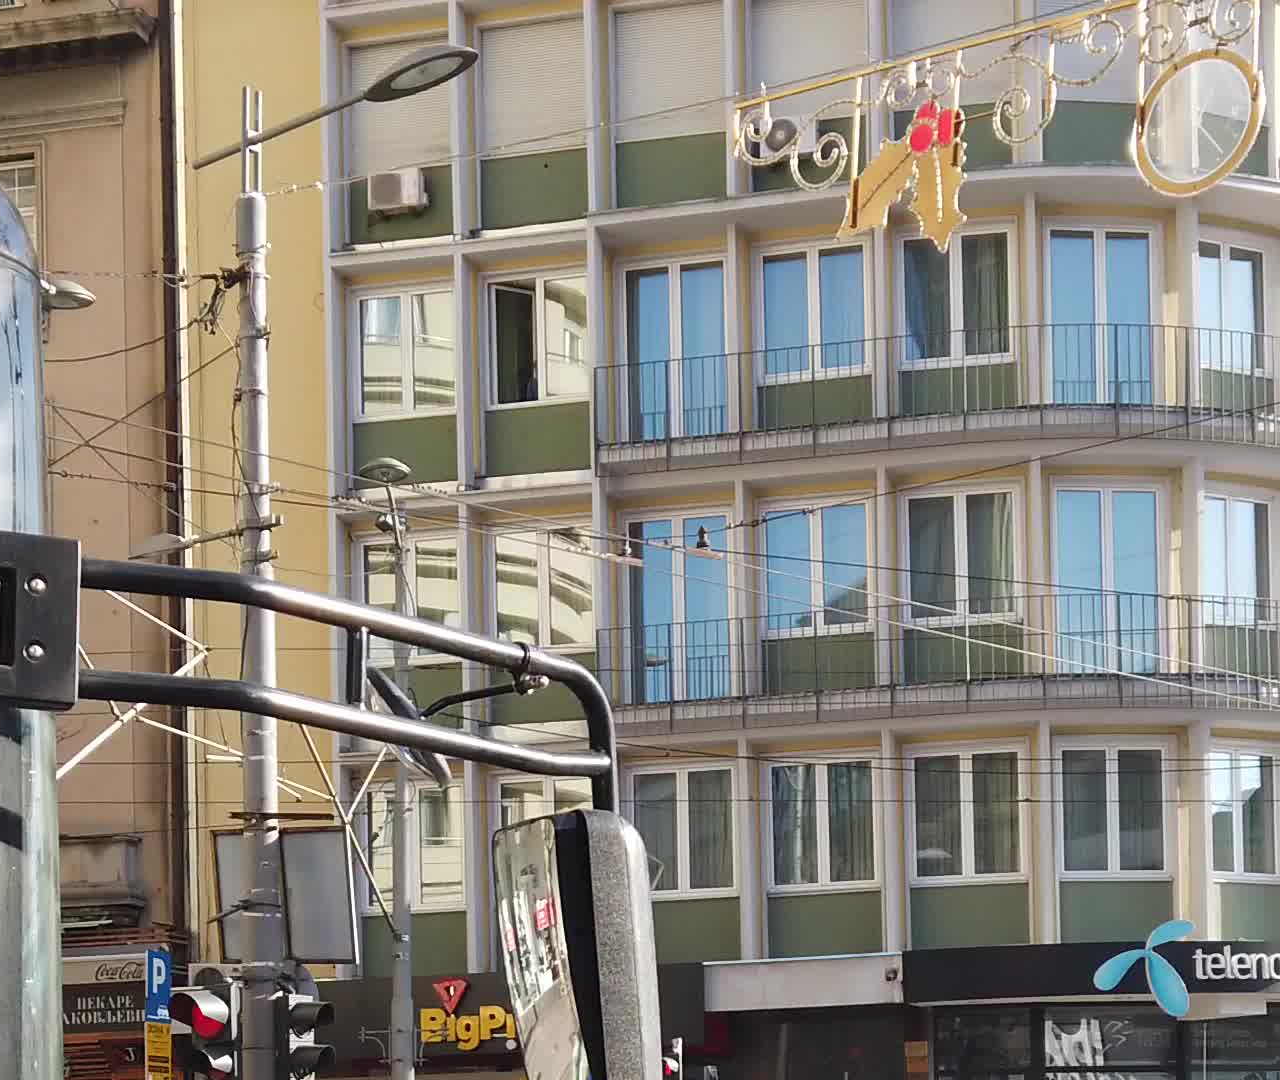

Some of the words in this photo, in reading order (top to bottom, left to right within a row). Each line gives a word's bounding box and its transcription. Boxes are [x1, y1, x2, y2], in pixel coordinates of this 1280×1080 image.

[152, 957, 167, 994] P
[77, 995, 134, 1010] ПЕКАРЕ
[420, 1005, 516, 1051] BigPi
